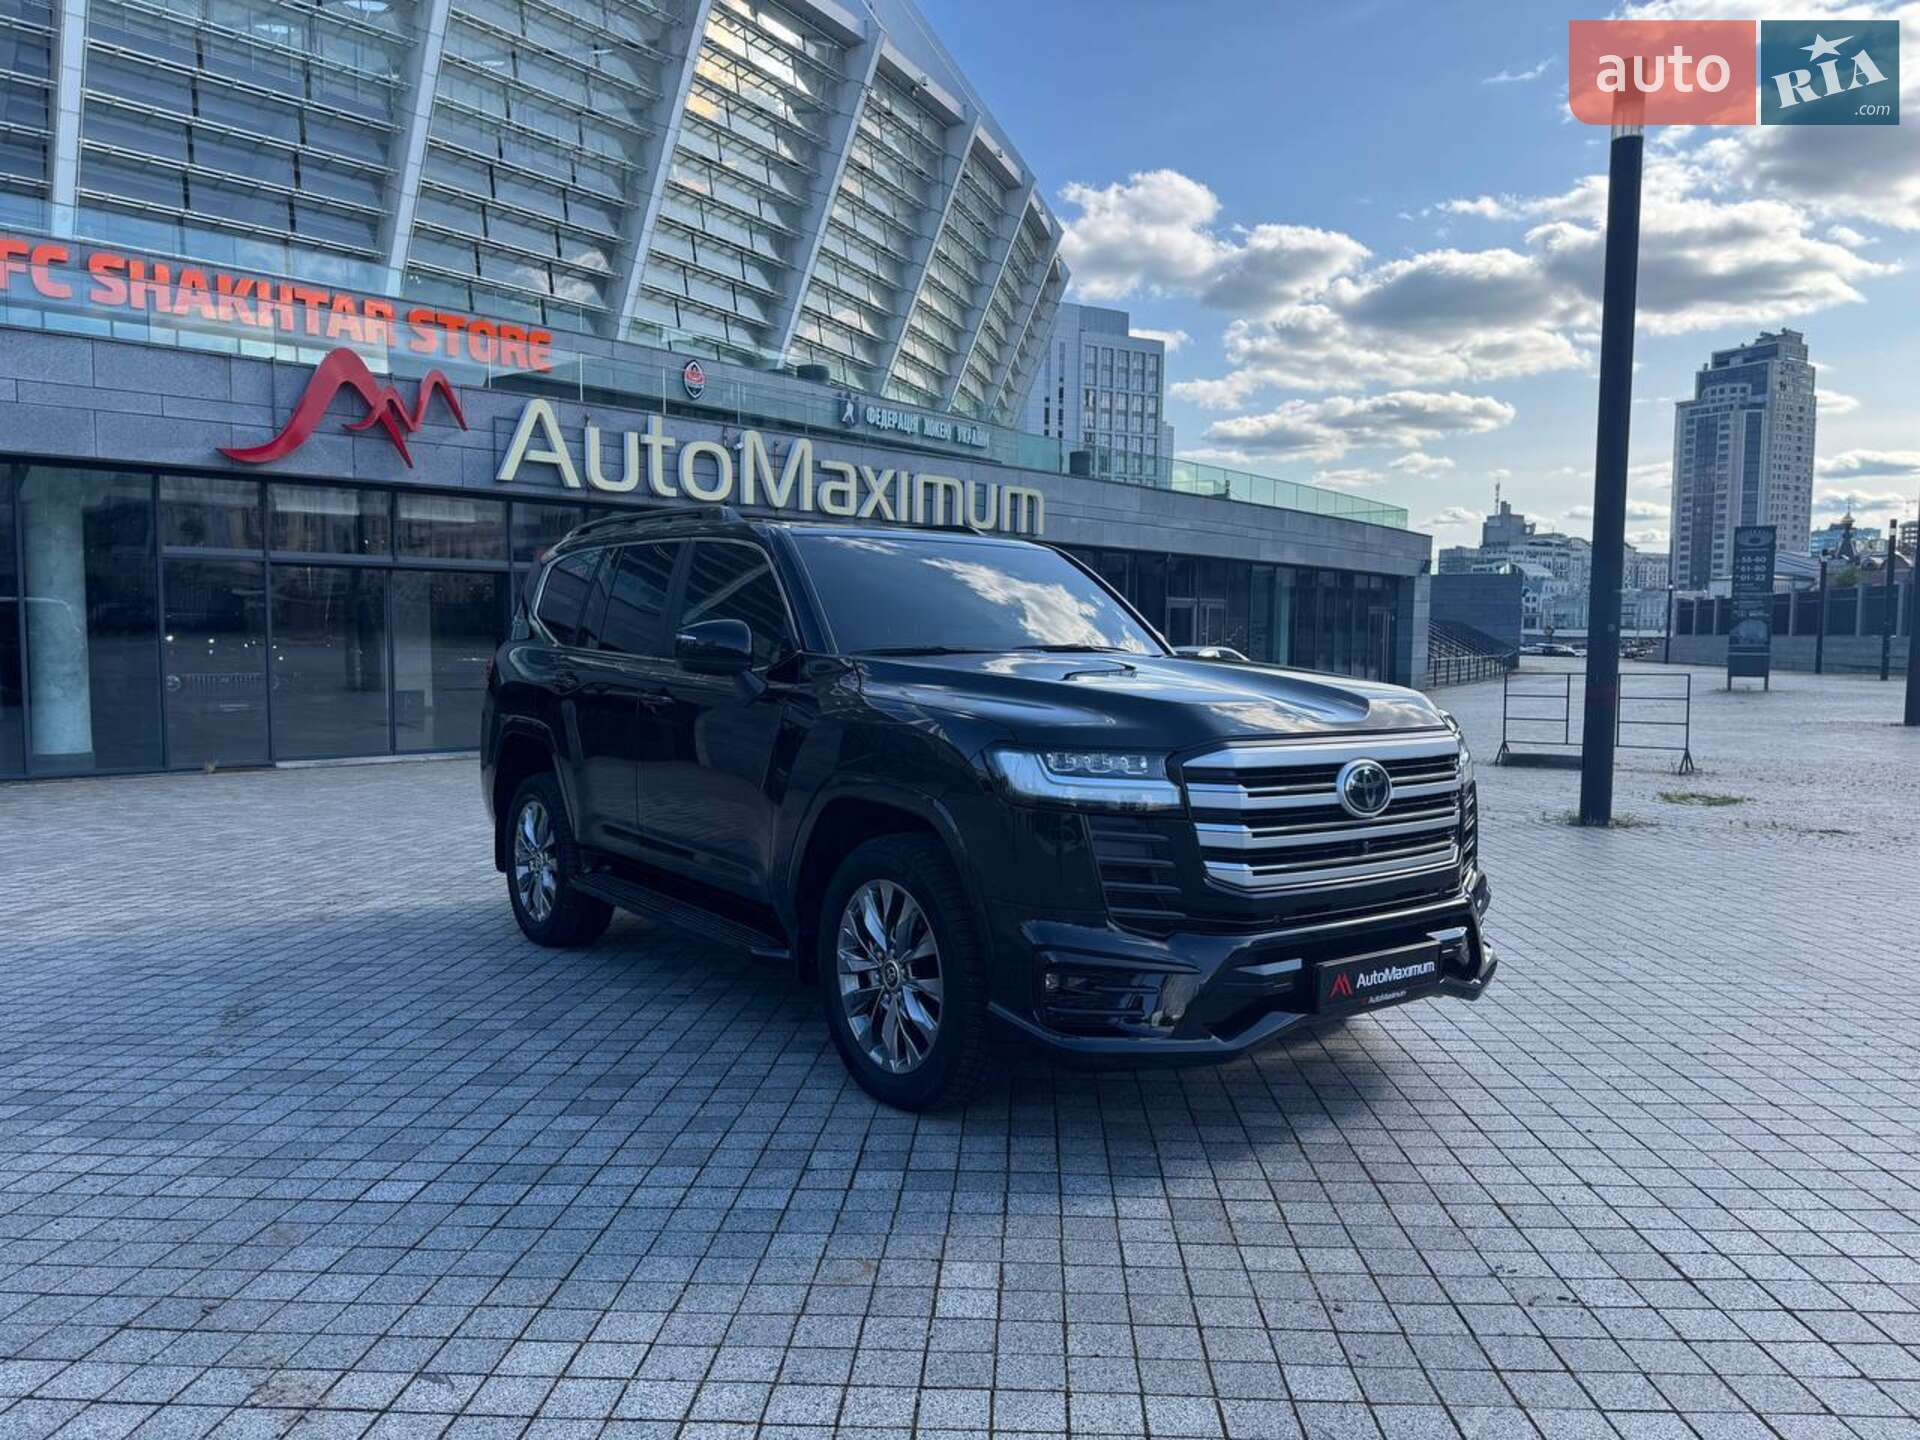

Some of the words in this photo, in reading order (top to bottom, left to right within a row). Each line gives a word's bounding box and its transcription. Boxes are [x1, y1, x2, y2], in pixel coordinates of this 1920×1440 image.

[0, 238, 73, 299] FC
[88, 251, 396, 348] SHAKHTAR
[408, 307, 554, 373] STORE
[496, 398, 1045, 536] AutoMaximum
[1356, 961, 1435, 989] AutoMaximum
